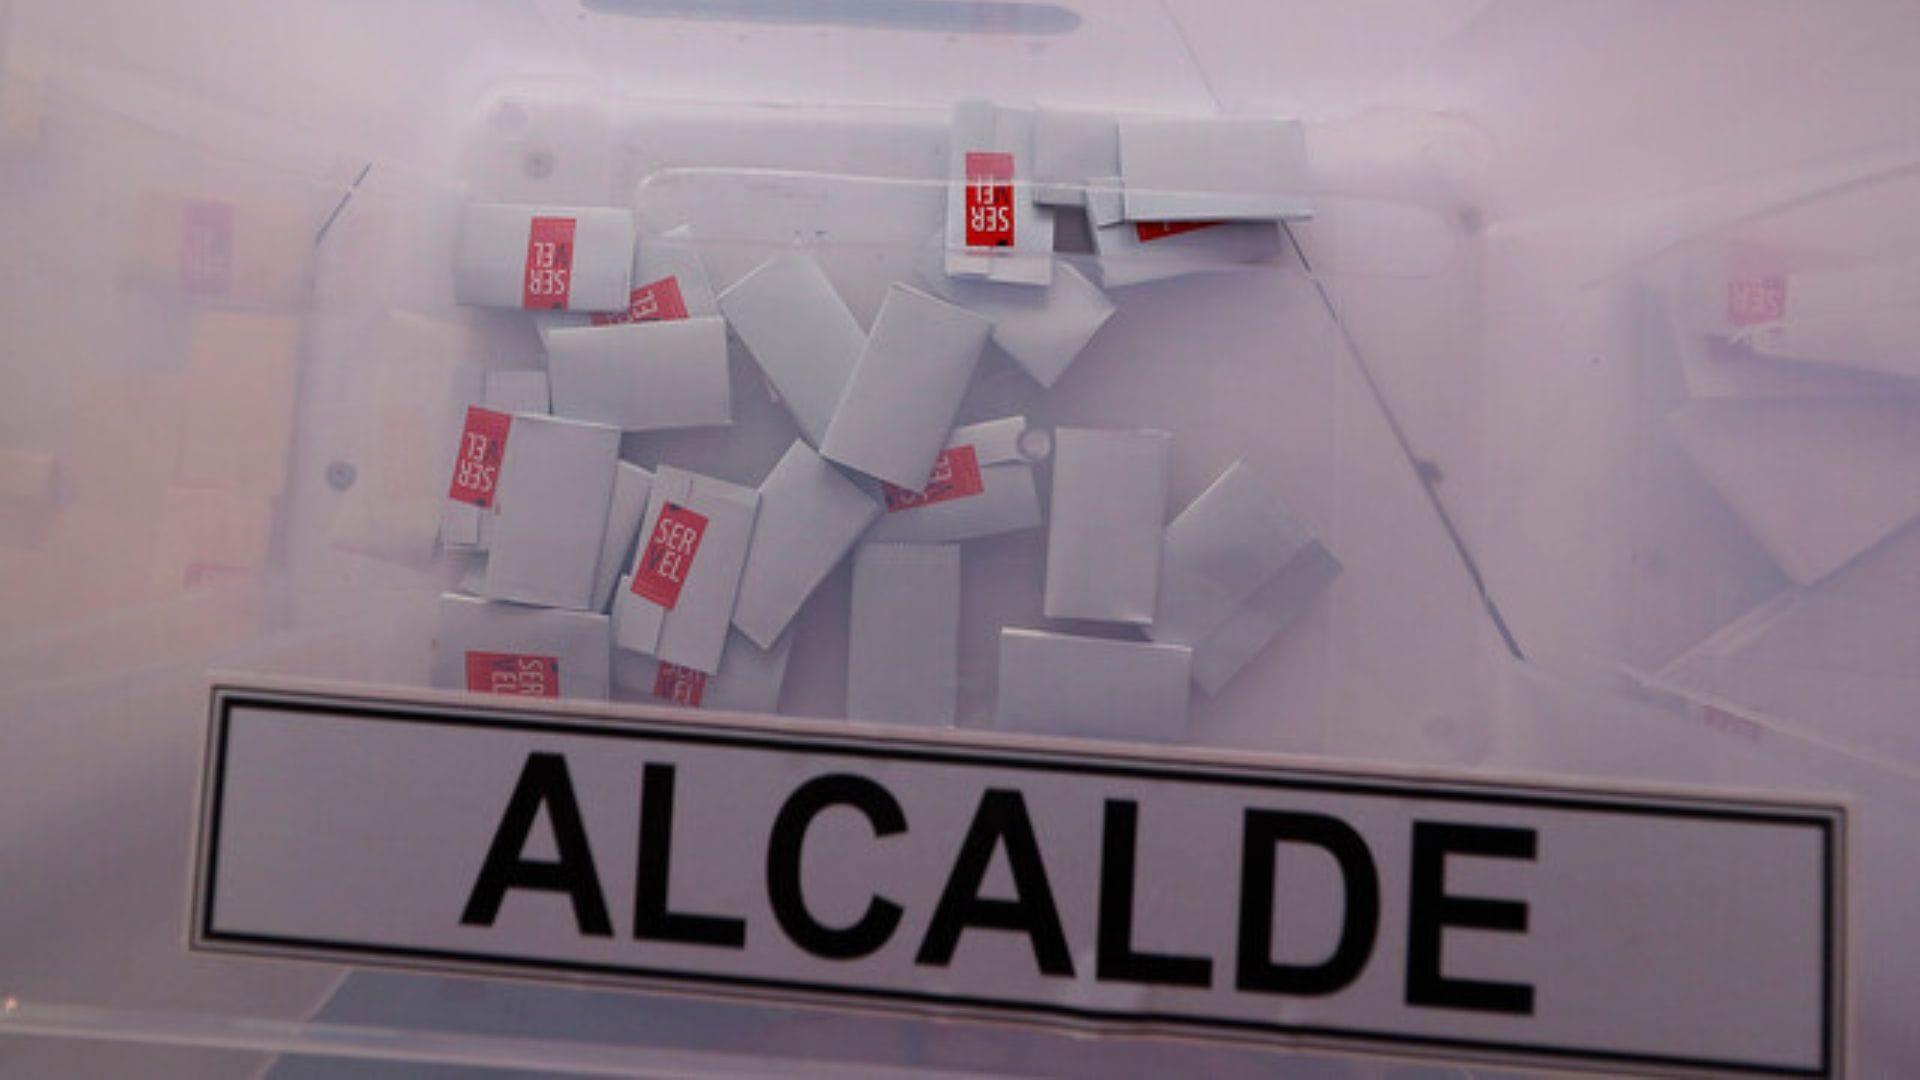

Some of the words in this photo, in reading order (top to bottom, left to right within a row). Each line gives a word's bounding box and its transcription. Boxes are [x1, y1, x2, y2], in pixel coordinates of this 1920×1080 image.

[970, 206, 1010, 232] SER
[528, 269, 567, 295] SER
[458, 459, 495, 493] SER
[655, 518, 697, 556] SER
[459, 751, 1538, 1017] ALCALDE
